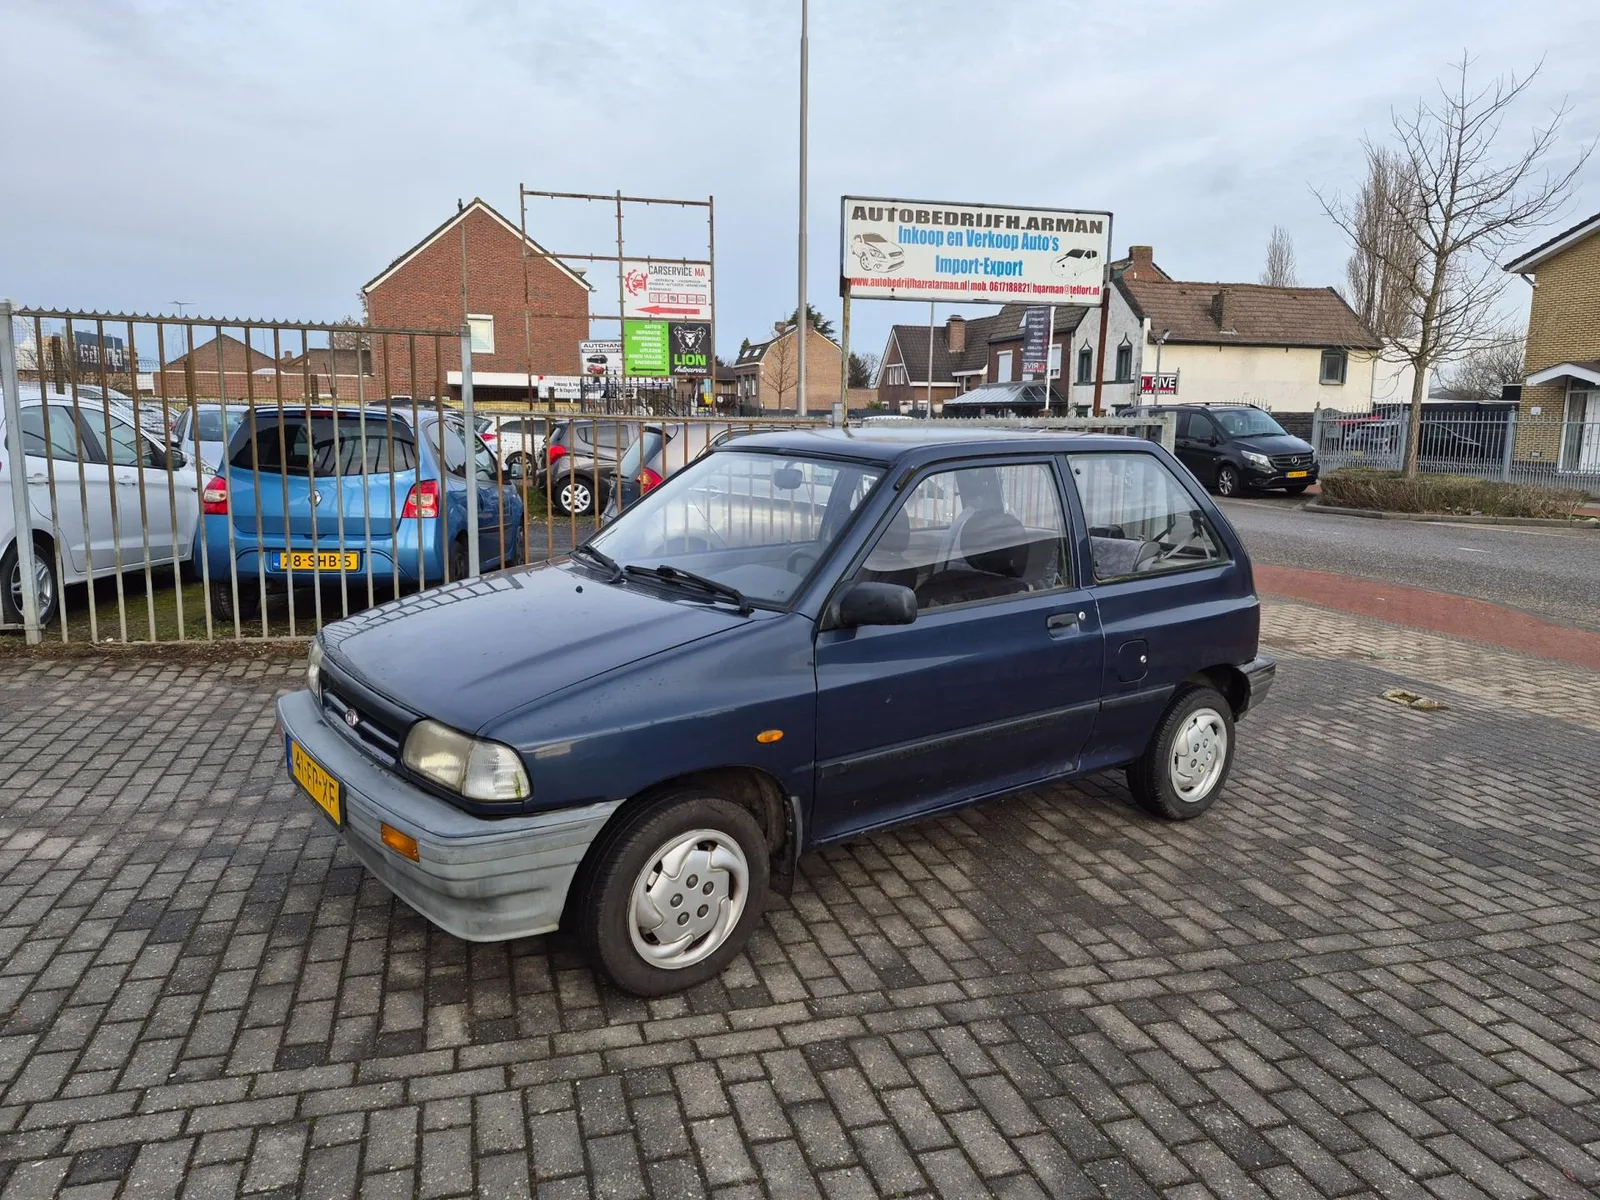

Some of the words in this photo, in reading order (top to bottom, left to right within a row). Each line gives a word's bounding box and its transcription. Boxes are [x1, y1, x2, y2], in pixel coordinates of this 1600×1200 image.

[898, 225, 943, 247] Inkoop
[947, 232, 963, 247] en
[966, 229, 1019, 251] Verkoop
[1021, 231, 1060, 252] Auto's
[648, 265, 692, 277] CARSERVICE
[694, 268, 706, 277] MA
[935, 255, 1023, 277] Import-Export
[970, 282, 987, 291] mob.
[989, 281, 1030, 293] 0617188821
[674, 354, 706, 366] LION
